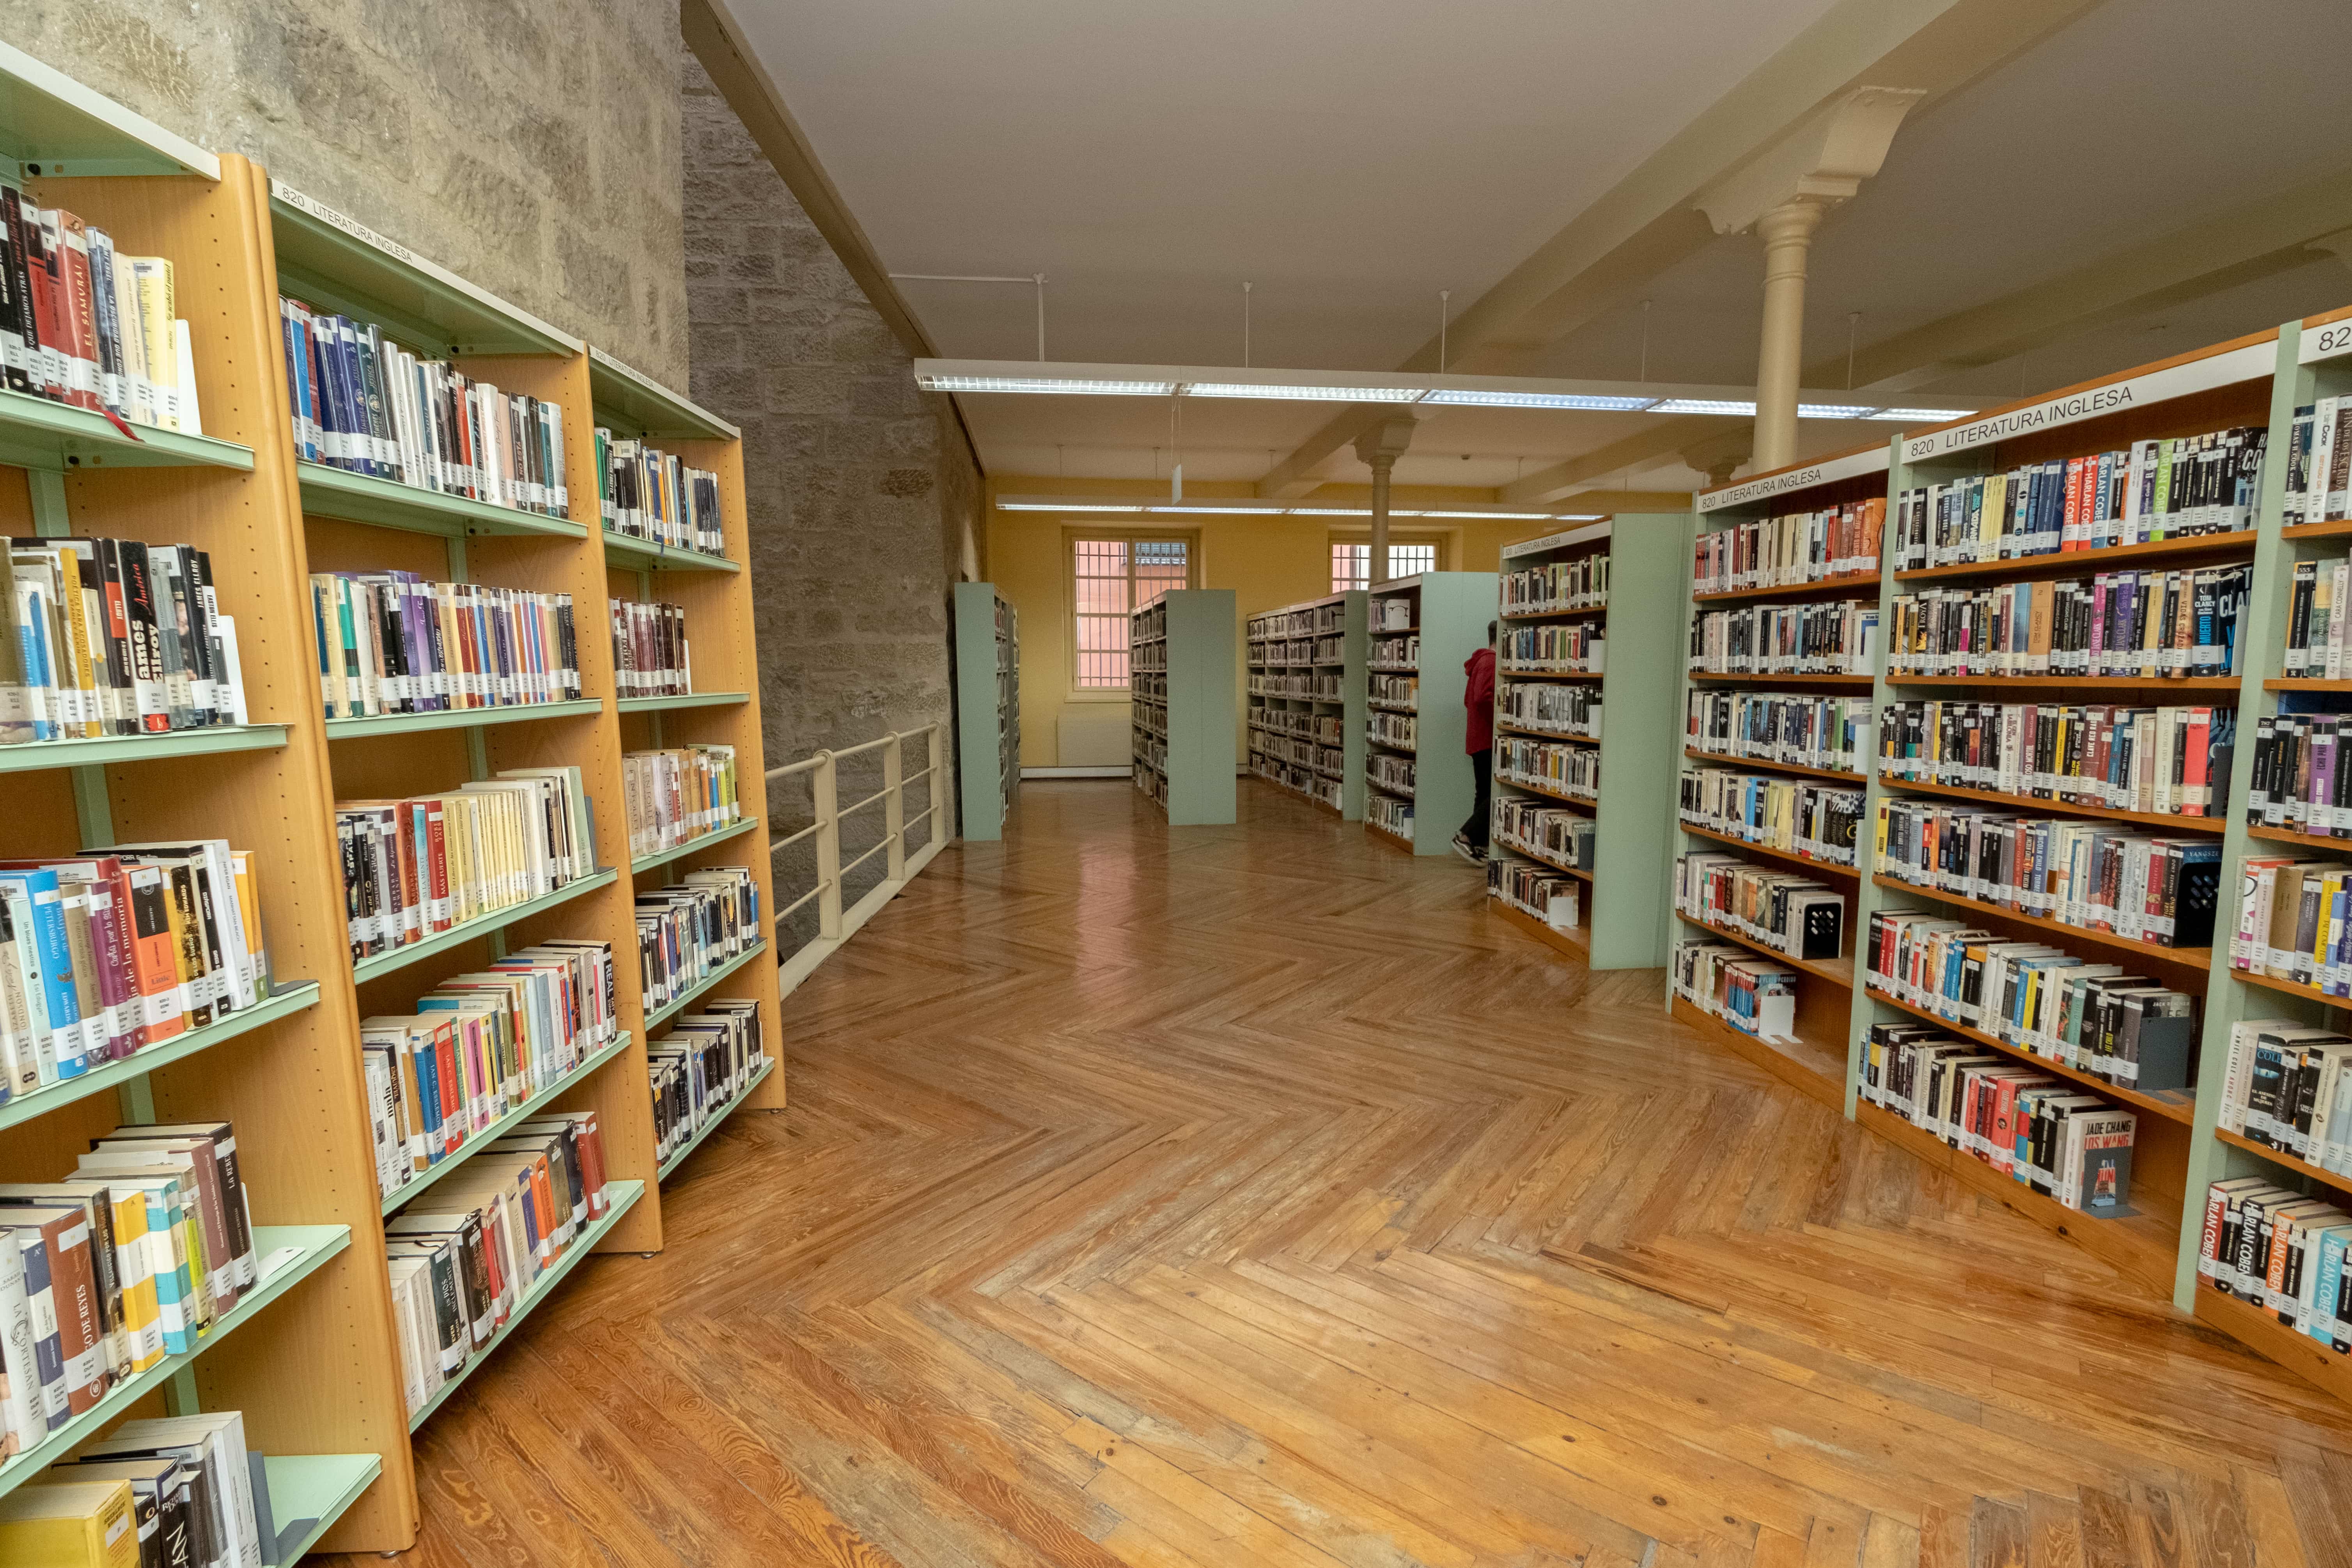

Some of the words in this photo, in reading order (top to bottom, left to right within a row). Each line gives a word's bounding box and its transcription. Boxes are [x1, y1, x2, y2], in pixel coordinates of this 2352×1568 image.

[282, 188, 304, 207] 820
[312, 202, 373, 243] LITERATURA
[376, 235, 412, 263] INGLESA
[19, 271, 27, 294] ATRÁS
[23, 296, 33, 328] DEJAMOS
[109, 296, 114, 304] LA
[167, 313, 173, 322] Se
[85, 333, 92, 346] EL
[2319, 327, 2350, 351] 82
[1911, 439, 1934, 456] 820
[1946, 410, 2044, 447] LITERATURA
[2050, 387, 2132, 422] INGLESA
[2344, 429, 2350, 438] DE
[2336, 452, 2348, 491] ESCRIBA
[1702, 496, 1715, 508] 820
[1722, 481, 1775, 503] LITERATURA
[1778, 469, 1820, 490] INGLESA
[2083, 472, 2093, 506] HARLAN
[2081, 508, 2090, 525] COB
[1515, 540, 1539, 554] LITERATURA
[1541, 537, 1560, 547] INGLESA
[191, 560, 201, 585] ELLROY
[133, 563, 151, 615] América
[115, 601, 123, 620] ELLROY
[1918, 603, 1927, 629] TROYA
[2179, 601, 2187, 620] VIDAS
[71, 576, 80, 606] POÉTICA
[80, 629, 90, 677] ACOSADORES
[2176, 624, 2185, 650] CRUZADA
[2200, 616, 2211, 645] MUERTO
[2317, 758, 2326, 770] ECHO
[422, 881, 427, 889] LA
[180, 885, 190, 912] EDWARDS
[202, 892, 212, 920] DIÁSPORA
[44, 906, 59, 959] PETERSBURGO
[57, 907, 66, 941] BRUJAS
[62, 943, 67, 952] de
[116, 897, 130, 948] memoria
[108, 930, 117, 943] por
[122, 953, 132, 964] la
[126, 968, 134, 982] de
[35, 992, 44, 1016] Edugyan
[2257, 1050, 2281, 1063] COLE
[2226, 1076, 2235, 1099] AHORC
[433, 1090, 442, 1129] ESSLEMON
[1999, 1090, 2010, 1114] PROSCRITO
[2085, 1123, 2104, 1135] JADE
[2106, 1120, 2132, 1133] CHANG
[2084, 1137, 2099, 1150] LOS
[2103, 1134, 2129, 1148] WANG
[229, 1176, 235, 1189] LA
[442, 1279, 450, 1297] DIOS
[446, 1266, 457, 1312] INCLEMENTE
[13, 1303, 22, 1318] LA
[76, 1285, 89, 1318] REYES
[81, 1321, 91, 1334] DE
[11, 1319, 34, 1391] CORTESAN
